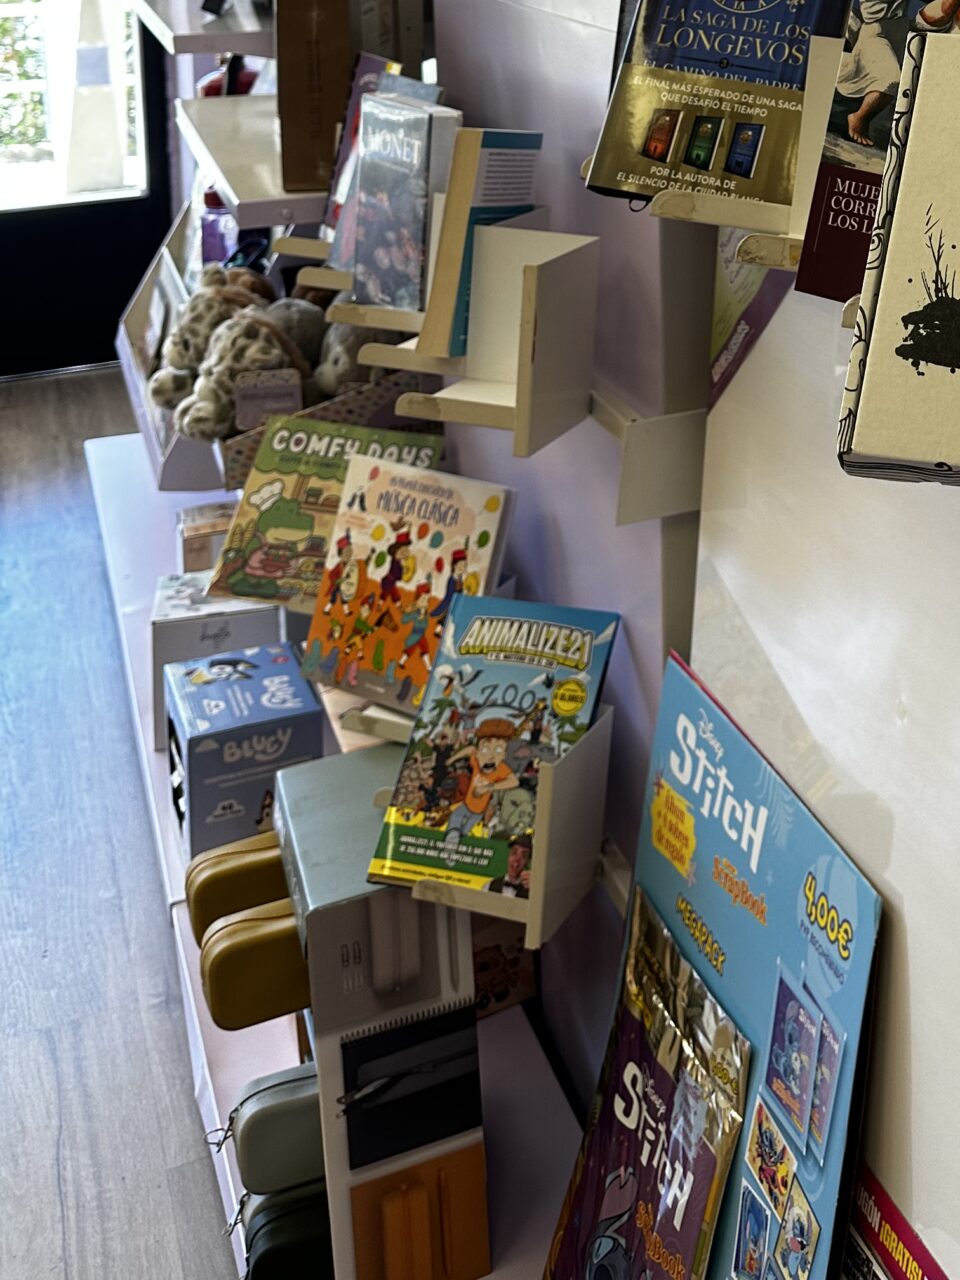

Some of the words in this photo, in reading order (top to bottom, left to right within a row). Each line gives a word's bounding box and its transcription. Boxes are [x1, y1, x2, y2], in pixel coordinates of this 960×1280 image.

[662, 5, 685, 23] LA
[691, 9, 737, 31] SAGA
[742, 17, 769, 35] DE
[773, 21, 811, 41] LOS
[655, 23, 806, 66] LONGEVOS
[645, 78, 670, 91] FINAL
[671, 81, 692, 94] MÁS
[693, 85, 740, 101] ESPERADO
[741, 92, 754, 103] DE
[756, 95, 776, 107] UNA
[778, 100, 802, 112] SAGA
[661, 91, 680, 103] QUE
[682, 95, 720, 110] DESAFIÓ
[733, 104, 768, 118] TIEMPO
[628, 174, 667, 190] SILENCIO
[650, 166, 670, 178] POR
[684, 173, 721, 187] AUTORA
[723, 180, 737, 191] DE
[827, 212, 858, 231] LOS
[272, 429, 360, 460] COMFY
[461, 619, 593, 669] ANIMALIZE21
[804, 872, 853, 960] 4,00€
[676, 894, 726, 976] MEGAPACK
